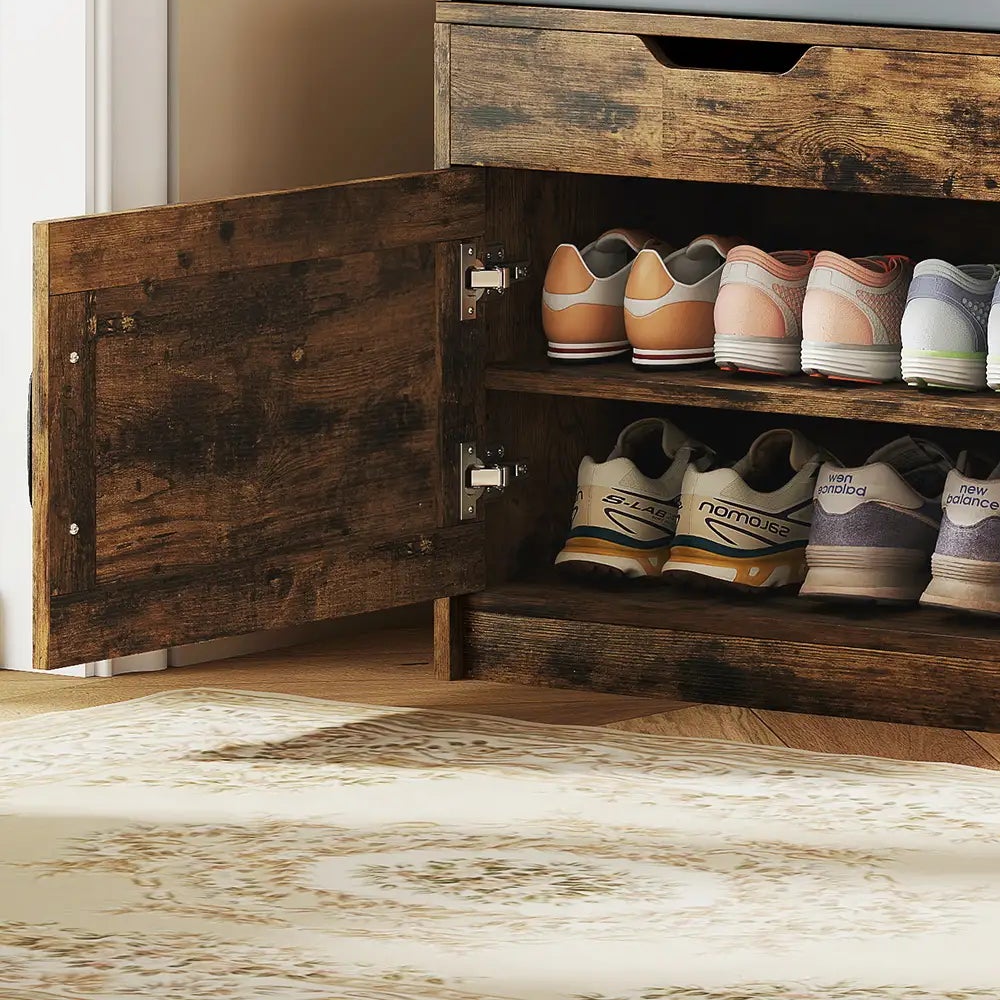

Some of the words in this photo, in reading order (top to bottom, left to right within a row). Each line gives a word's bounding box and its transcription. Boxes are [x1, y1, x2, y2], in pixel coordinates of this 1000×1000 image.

[960, 483, 989, 496] new
[602, 493, 667, 519] S-LAB
[946, 493, 1000, 511] balance
